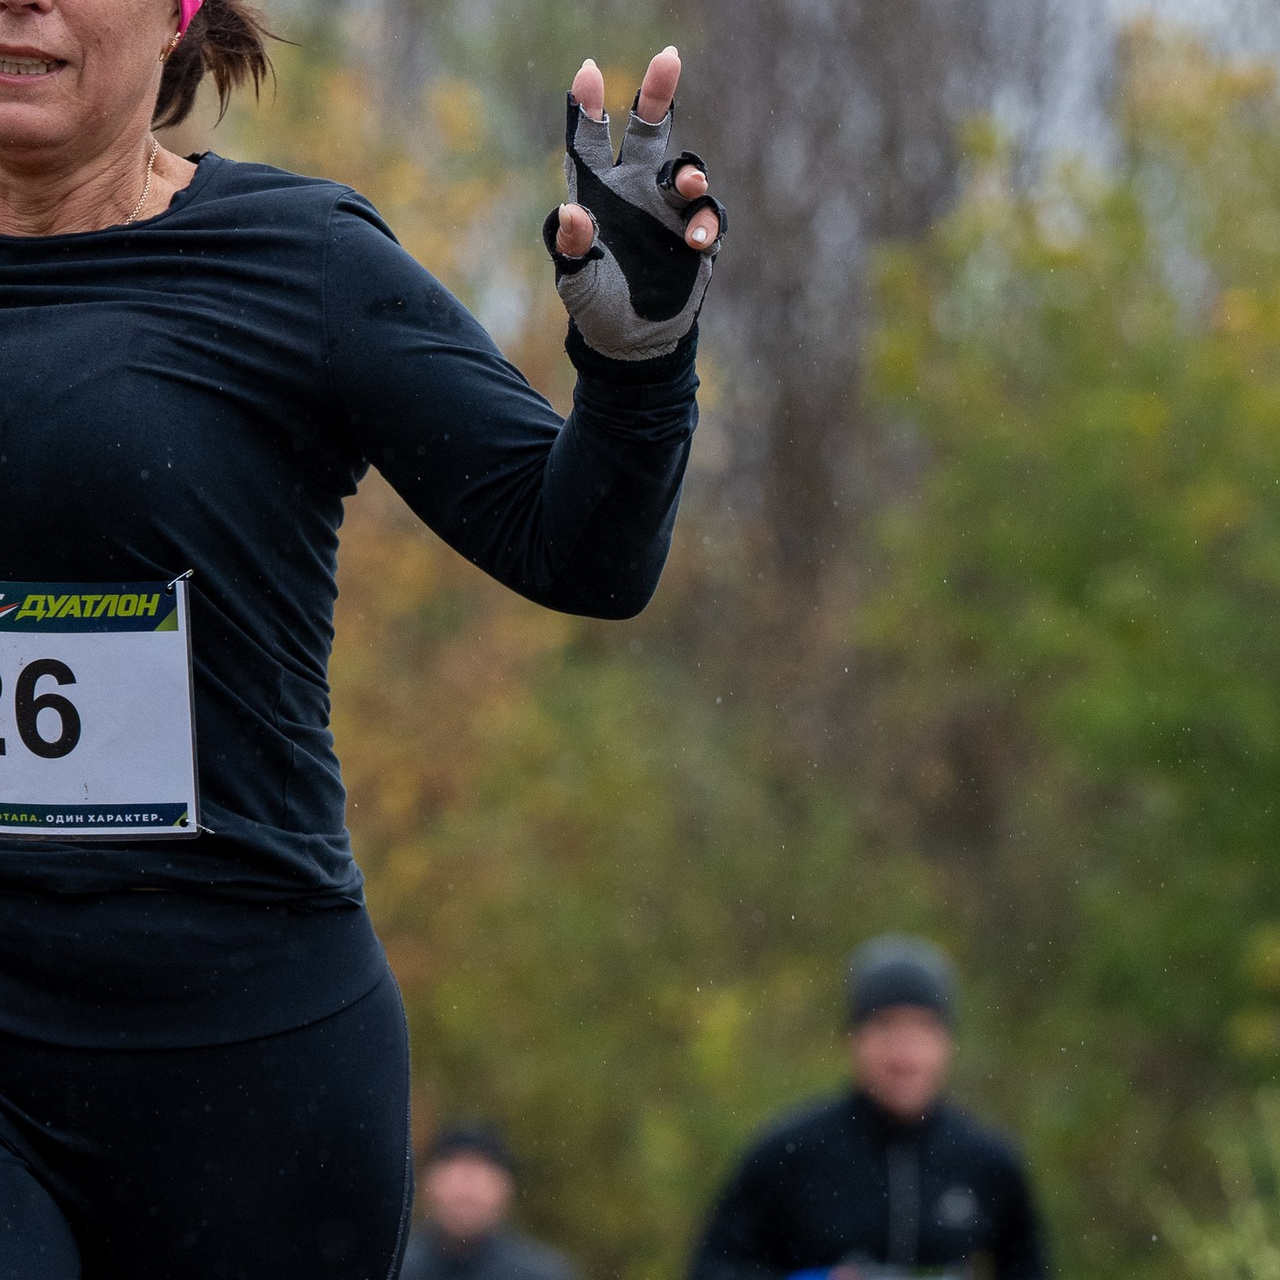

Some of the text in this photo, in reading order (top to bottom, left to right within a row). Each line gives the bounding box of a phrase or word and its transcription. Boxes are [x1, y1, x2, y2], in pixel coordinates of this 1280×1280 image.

[14, 593, 161, 622] ДУАТЛОН
[45, 814, 84, 824] ОДИН
[87, 813, 164, 823] ХАРАКТЕР.
